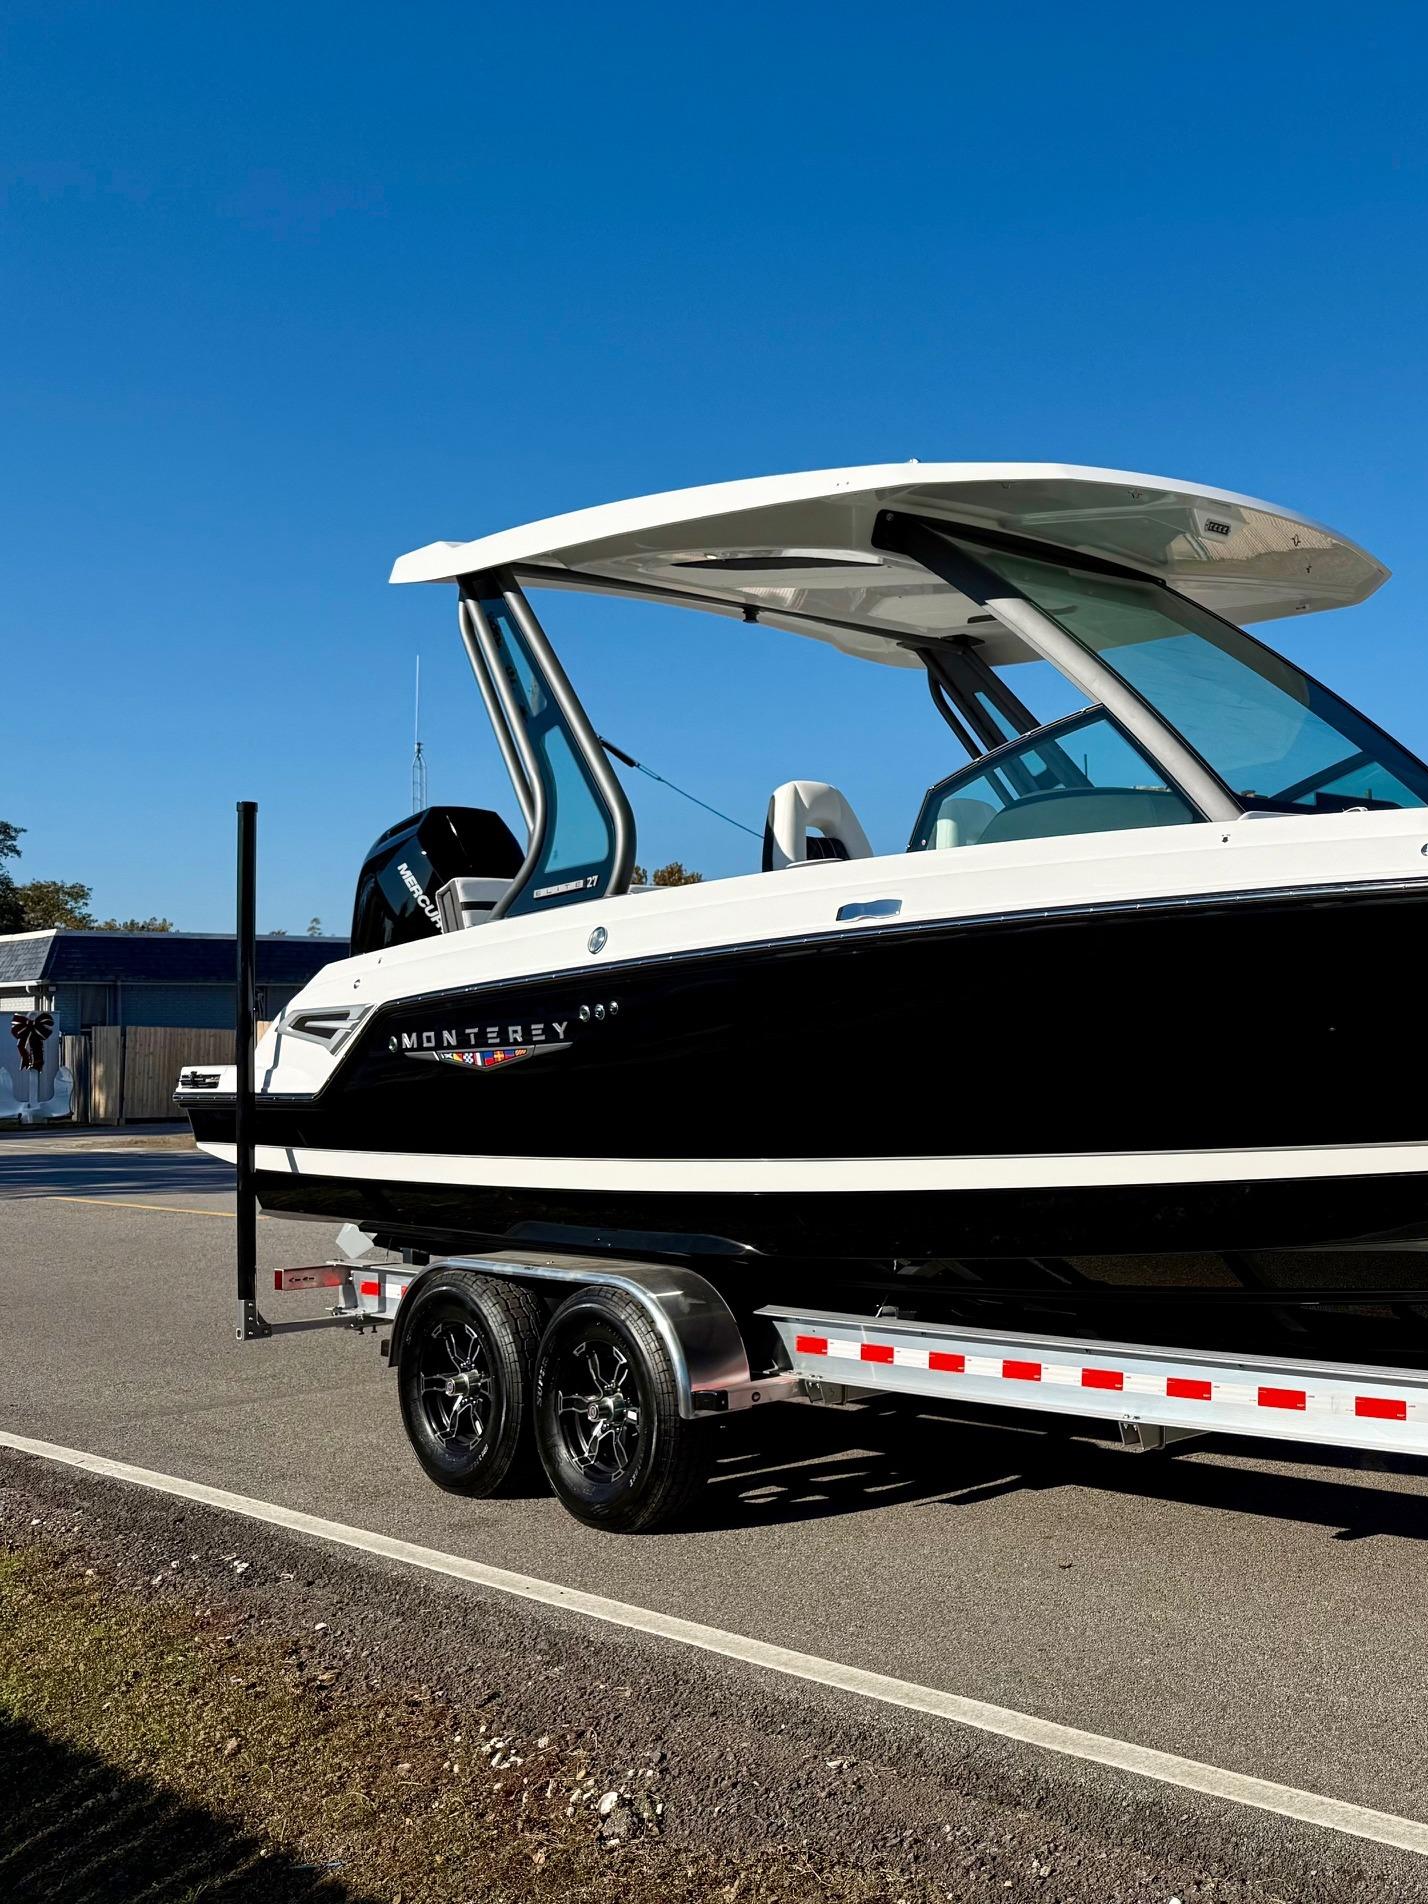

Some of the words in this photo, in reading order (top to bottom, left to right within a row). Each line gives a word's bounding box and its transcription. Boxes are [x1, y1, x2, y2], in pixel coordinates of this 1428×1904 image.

[586, 875, 599, 889] 27
[397, 863, 443, 933] MERCUR
[401, 1021, 568, 1049] MONTEREY
